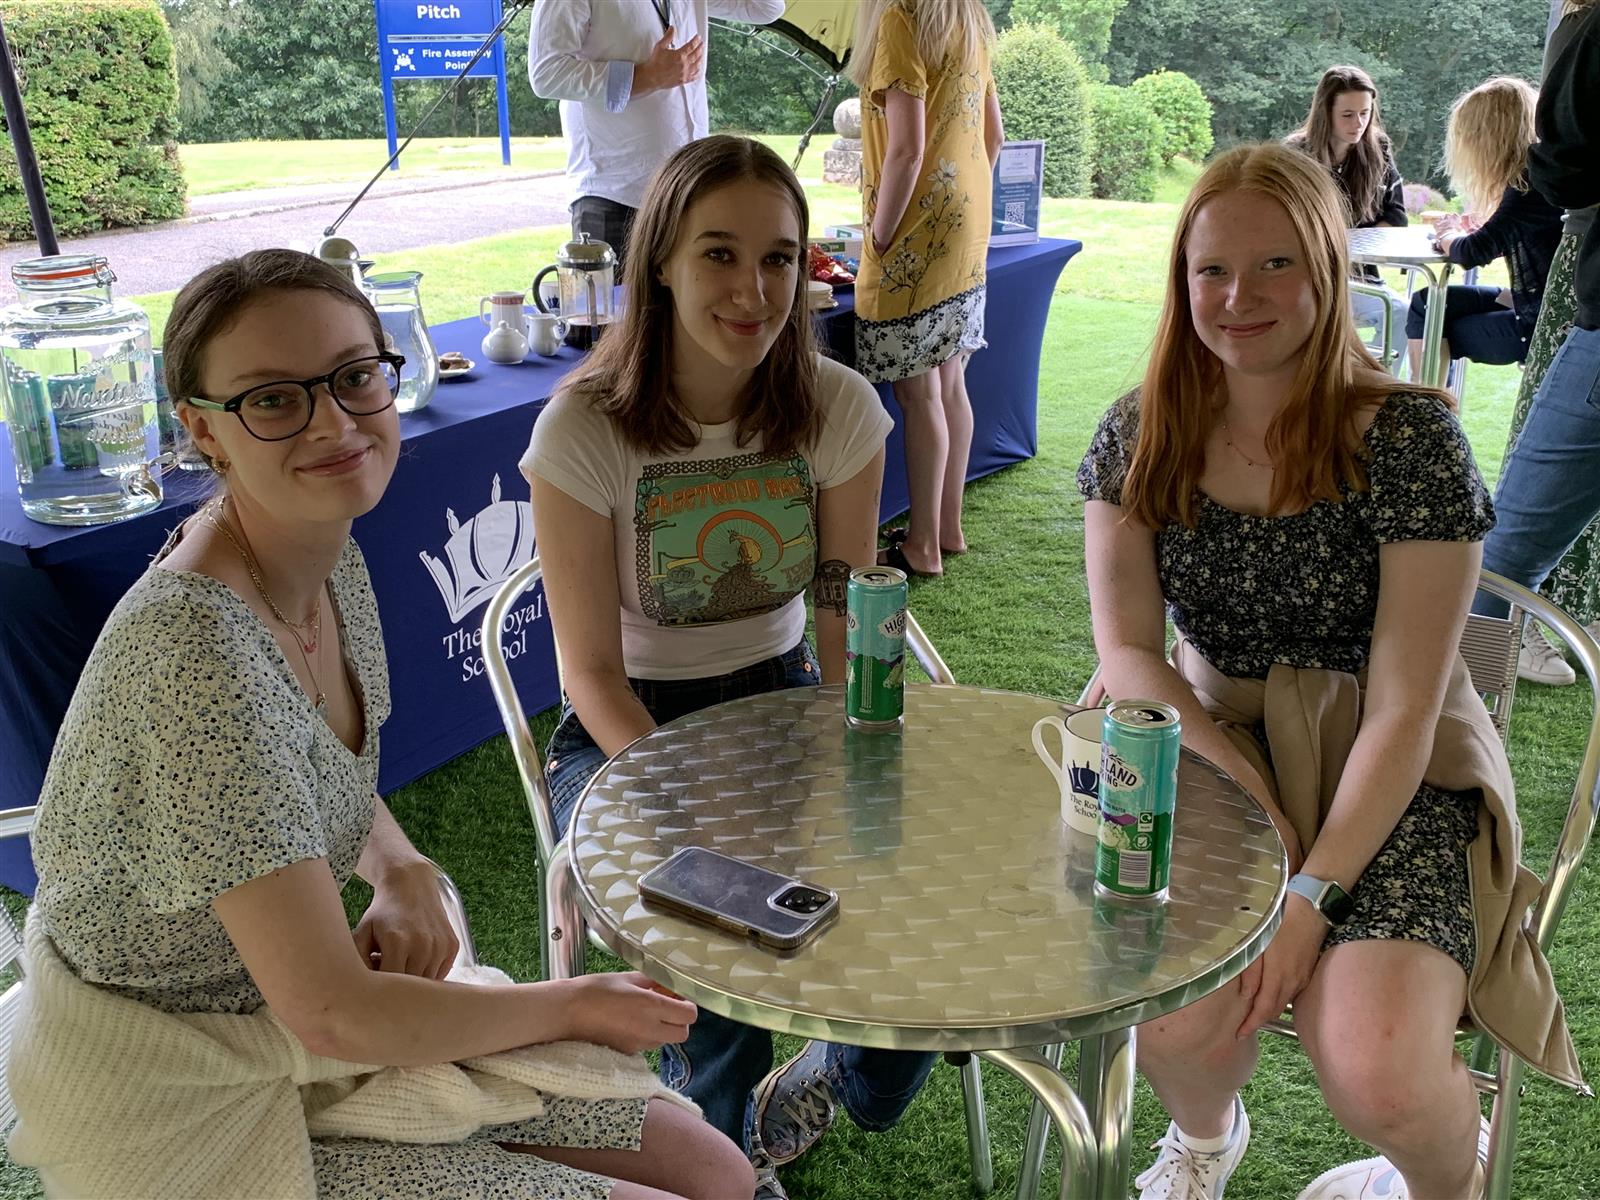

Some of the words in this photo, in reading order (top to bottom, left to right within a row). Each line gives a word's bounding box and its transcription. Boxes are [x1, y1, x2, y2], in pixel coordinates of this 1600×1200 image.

[416, 5, 460, 19] Pitch
[422, 48, 442, 58] Fire
[444, 48, 492, 59] Assemy
[443, 627, 482, 660] The
[502, 593, 543, 635] oyal
[462, 629, 527, 682] Scool
[1070, 792, 1083, 806] The
[1084, 799, 1098, 812] Roy
[1074, 805, 1098, 819] Schoo
